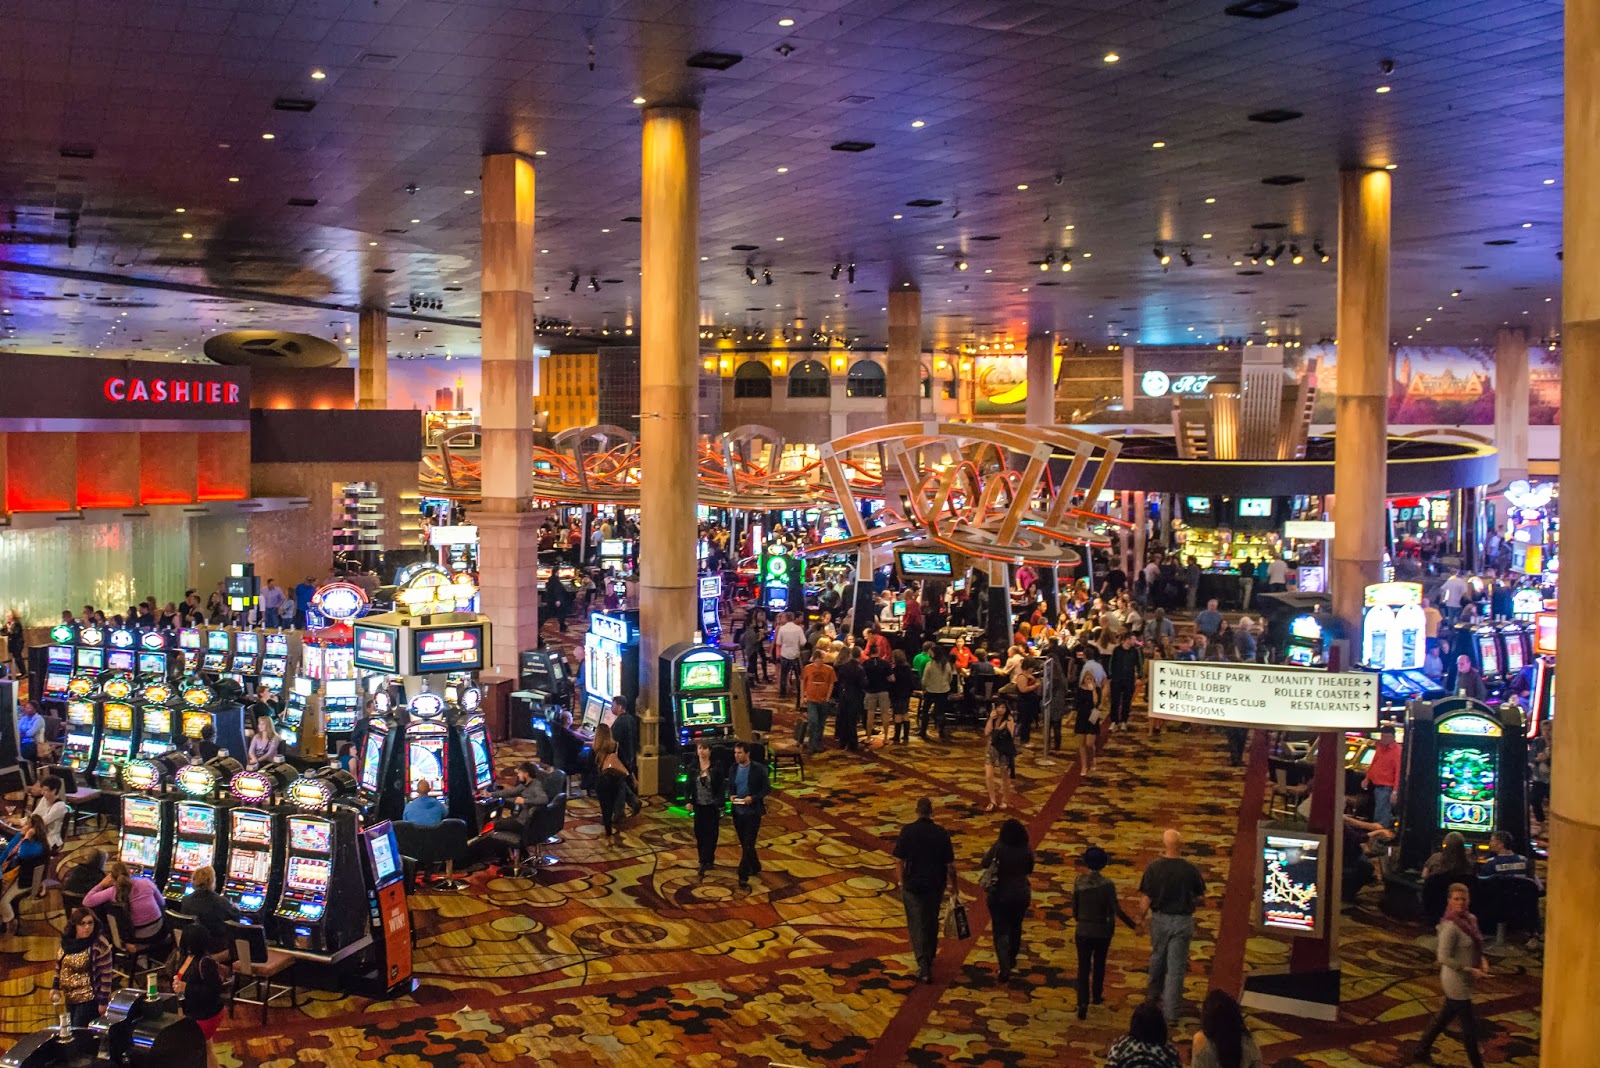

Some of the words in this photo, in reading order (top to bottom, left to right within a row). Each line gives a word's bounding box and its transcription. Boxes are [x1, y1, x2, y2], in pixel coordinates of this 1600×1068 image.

[103, 377, 240, 404] CASHIER
[1225, 672, 1251, 682] PARK
[1261, 675, 1315, 686] ZUMANITY
[1318, 677, 1361, 687] THEATER
[1169, 679, 1197, 691] HOTEL
[1200, 683, 1232, 693] LOBBY
[1274, 687, 1313, 698] ROLLER
[1315, 689, 1361, 700] COASTER
[1196, 695, 1239, 706] PLAYERS
[1240, 698, 1267, 708] CLUB
[1290, 700, 1361, 712] RESTAURANTS
[1169, 702, 1226, 717] RESTROOMS
[388, 912, 406, 933] WIN!
